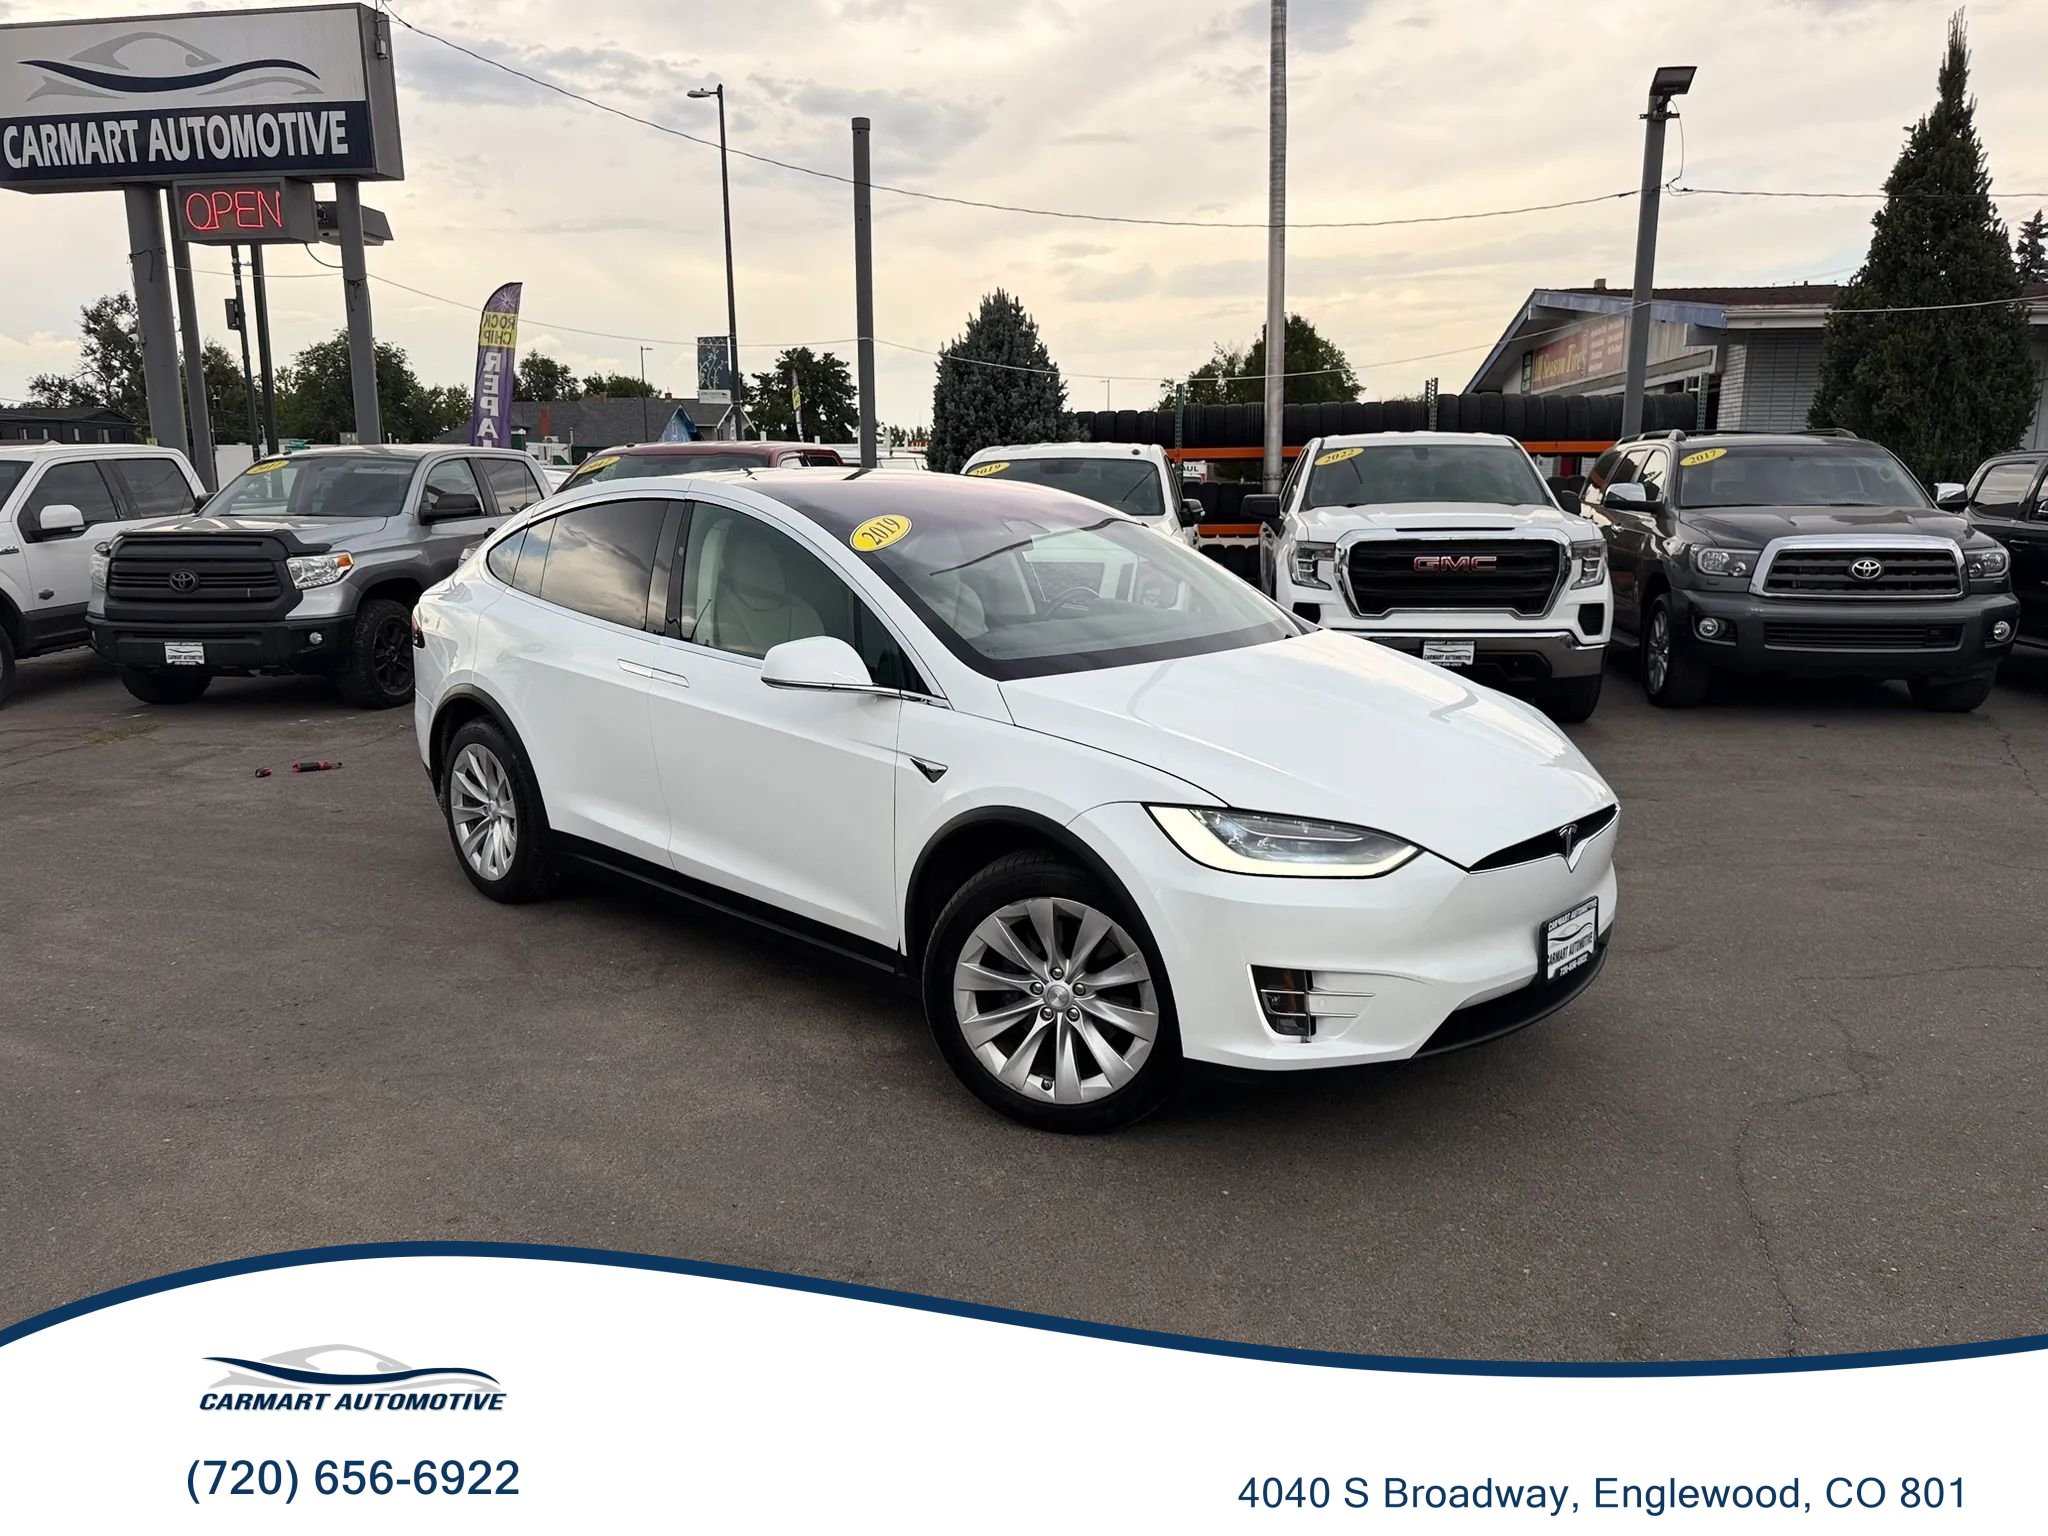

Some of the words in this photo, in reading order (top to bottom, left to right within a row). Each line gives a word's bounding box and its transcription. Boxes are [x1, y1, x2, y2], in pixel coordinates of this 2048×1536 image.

[2, 119, 139, 169] CARMART
[149, 110, 349, 162] AUTOMOTIVE
[185, 190, 283, 231] OPEN
[1689, 450, 1717, 463] 2017
[861, 517, 901, 545] 2019
[1413, 556, 1497, 572] GMC
